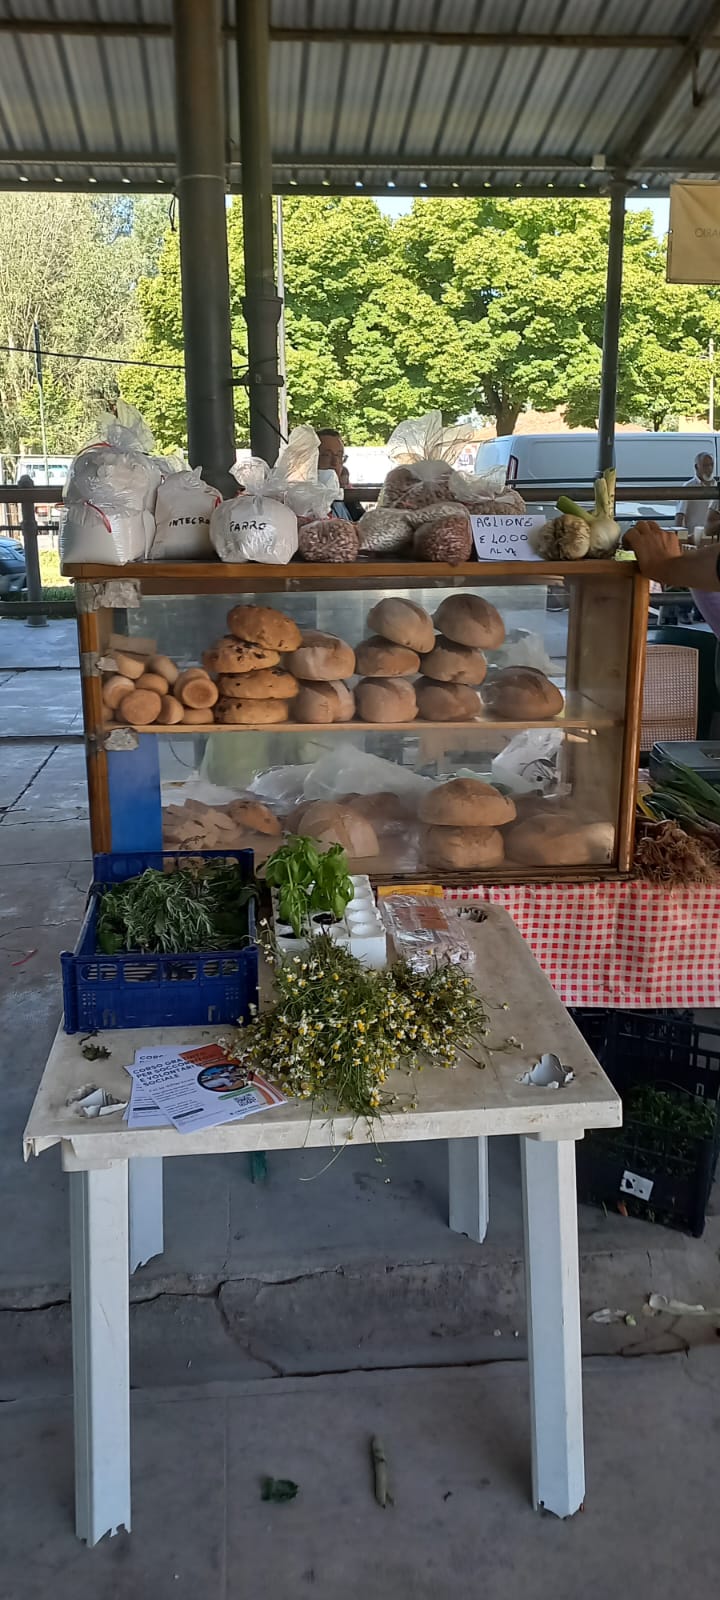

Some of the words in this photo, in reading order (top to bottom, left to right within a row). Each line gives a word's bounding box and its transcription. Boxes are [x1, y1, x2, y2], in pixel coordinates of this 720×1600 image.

[229, 520, 267, 532] FARRO
[476, 517, 533, 528] AGLIONE
[132, 1063, 164, 1075] CORSO
[136, 1071, 153, 1079] PER
[142, 1073, 180, 1087] SOCIALE
